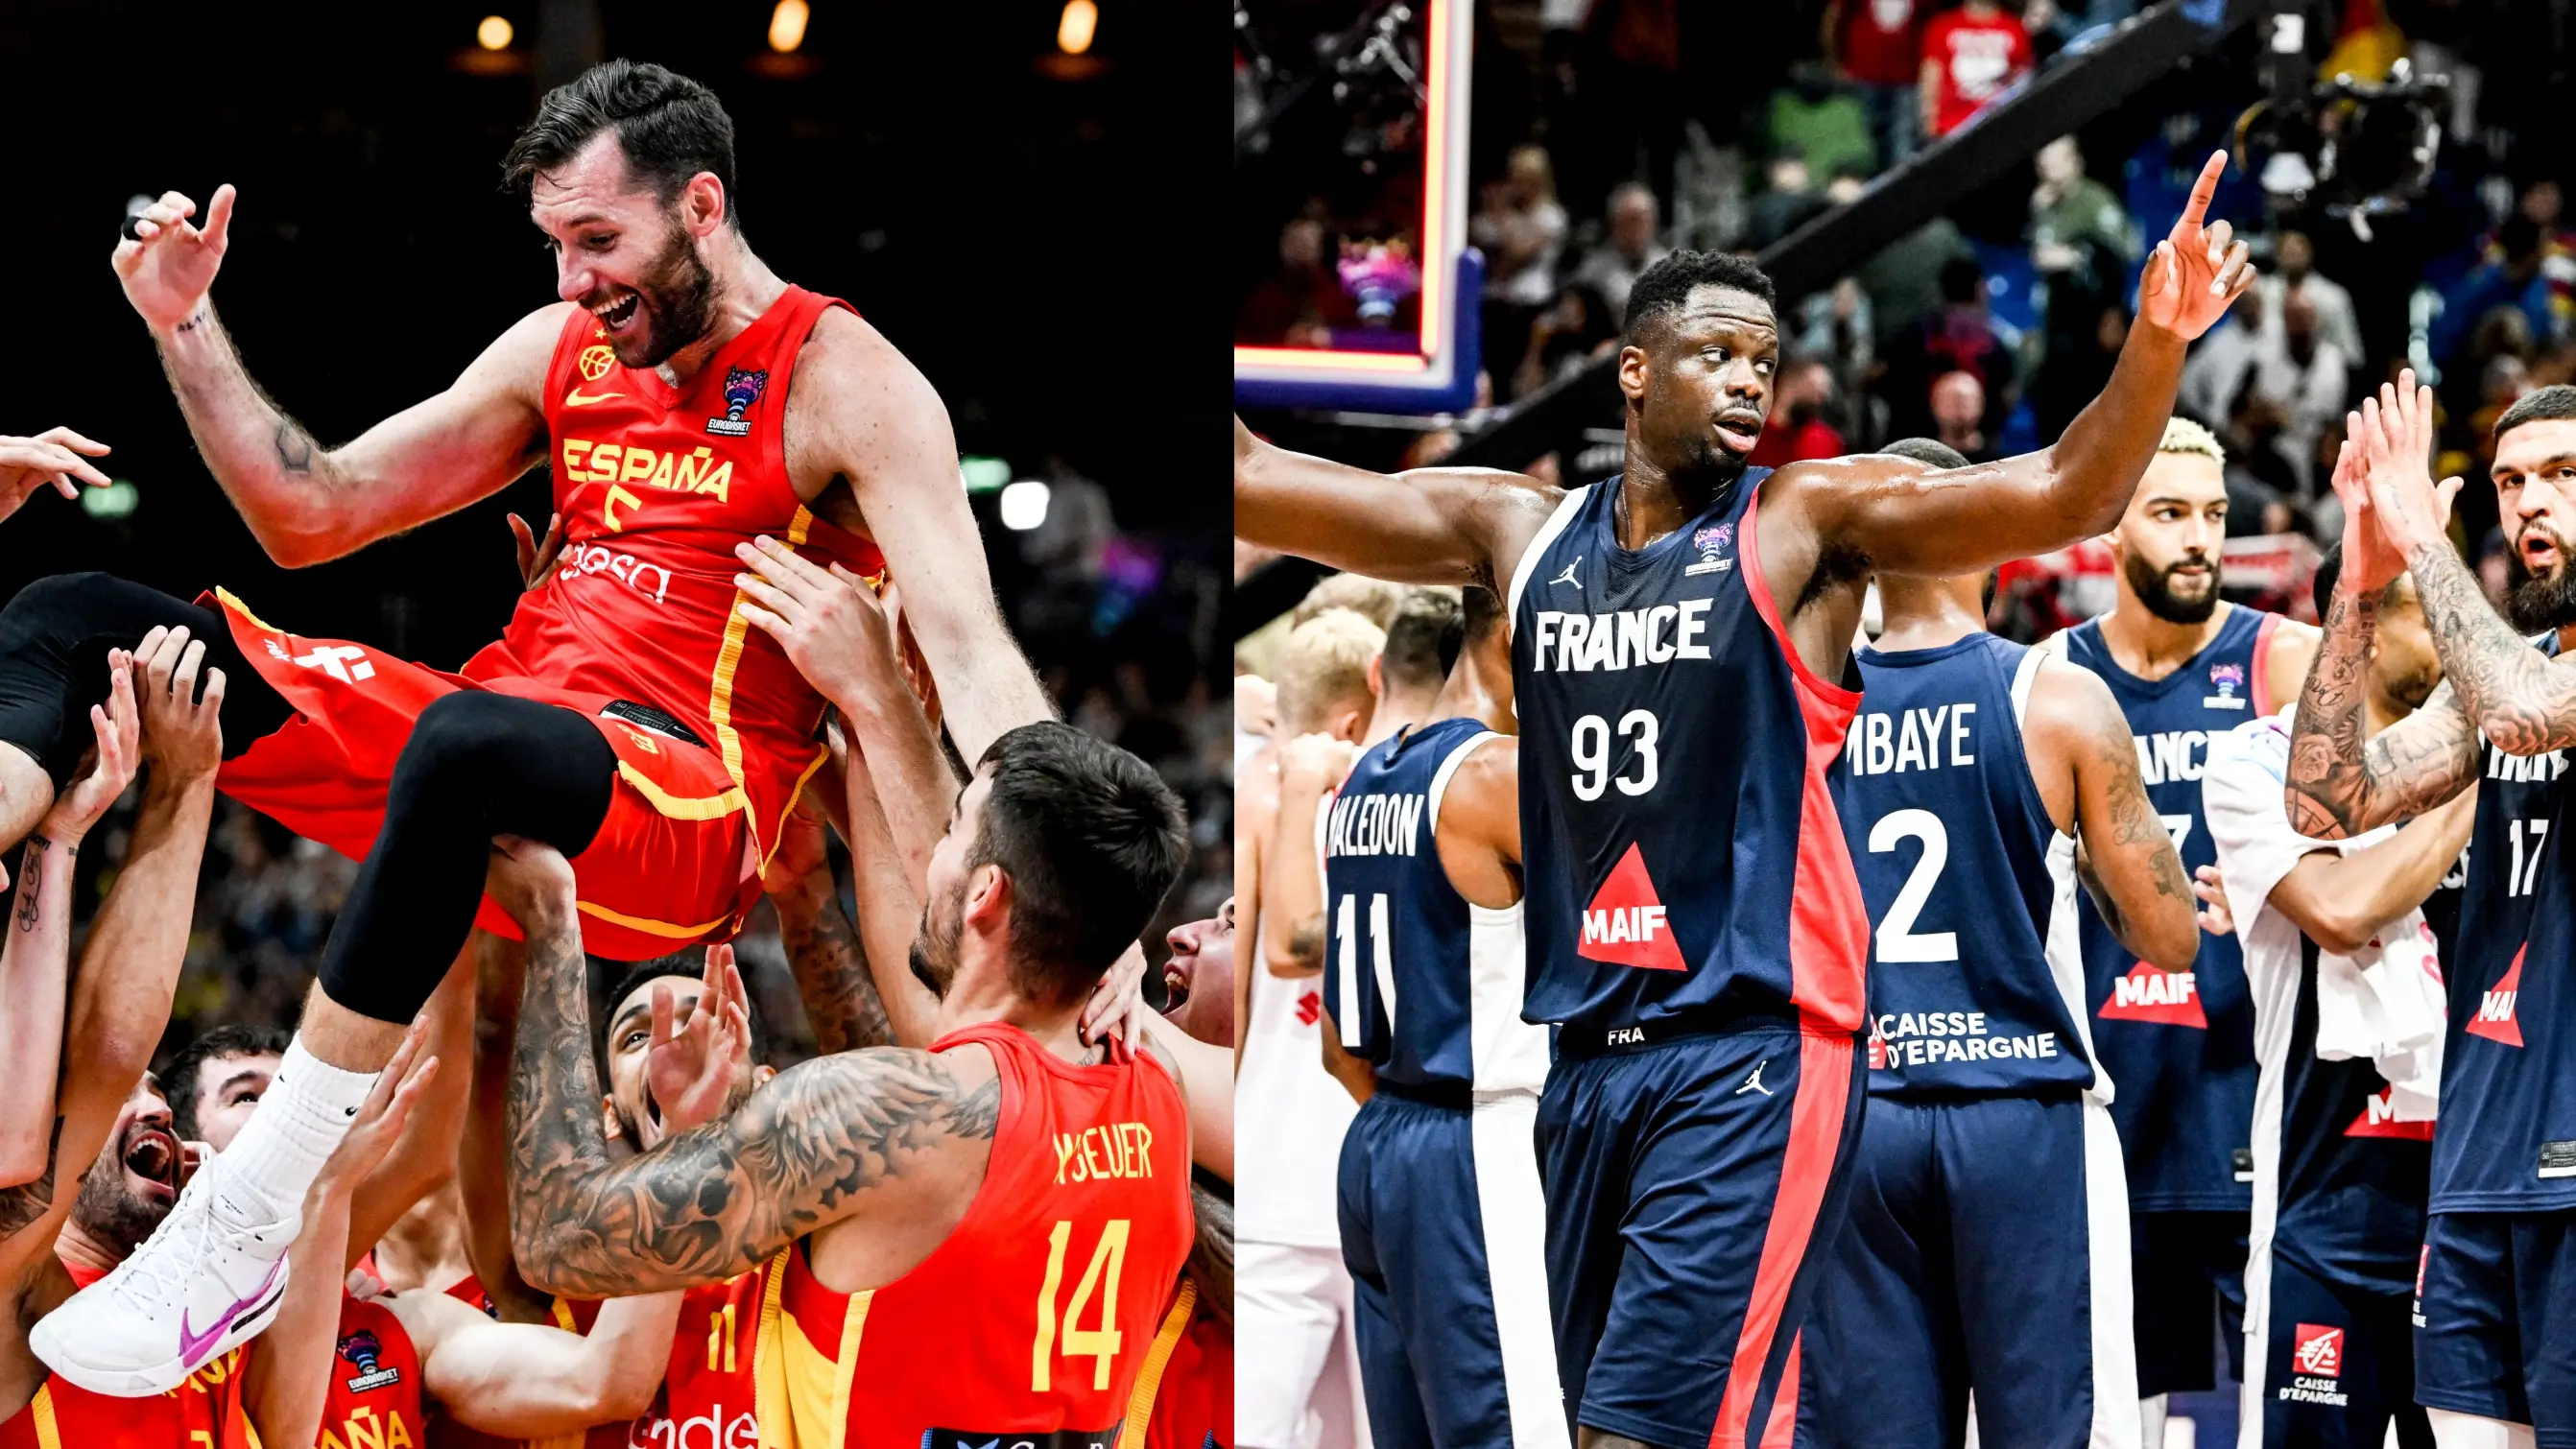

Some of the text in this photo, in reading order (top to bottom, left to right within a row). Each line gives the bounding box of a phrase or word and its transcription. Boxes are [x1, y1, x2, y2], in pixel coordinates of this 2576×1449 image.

[562, 438, 734, 504] ESPAÑA
[1534, 598, 1714, 672] FRANCE
[1571, 708, 1659, 802] 93
[2133, 729, 2232, 786] ANC
[2159, 814, 2193, 862] 7
[2508, 819, 2550, 897] 17
[1869, 808, 1959, 963] 2
[1583, 905, 1667, 945] MAIF
[1335, 892, 1397, 1048] 11
[2114, 972, 2196, 1008] MAIF
[1877, 1012, 1988, 1041] CAISSE
[2478, 990, 2517, 1023] MAI
[1608, 1027, 1646, 1046] FRA
[1885, 1033, 2058, 1070] D'EPARGNE
[1031, 1219, 1132, 1392] 14
[2294, 1376, 2338, 1392] CAISSE
[315, 1405, 414, 1449] AÑA
[628, 1403, 759, 1449] ende
